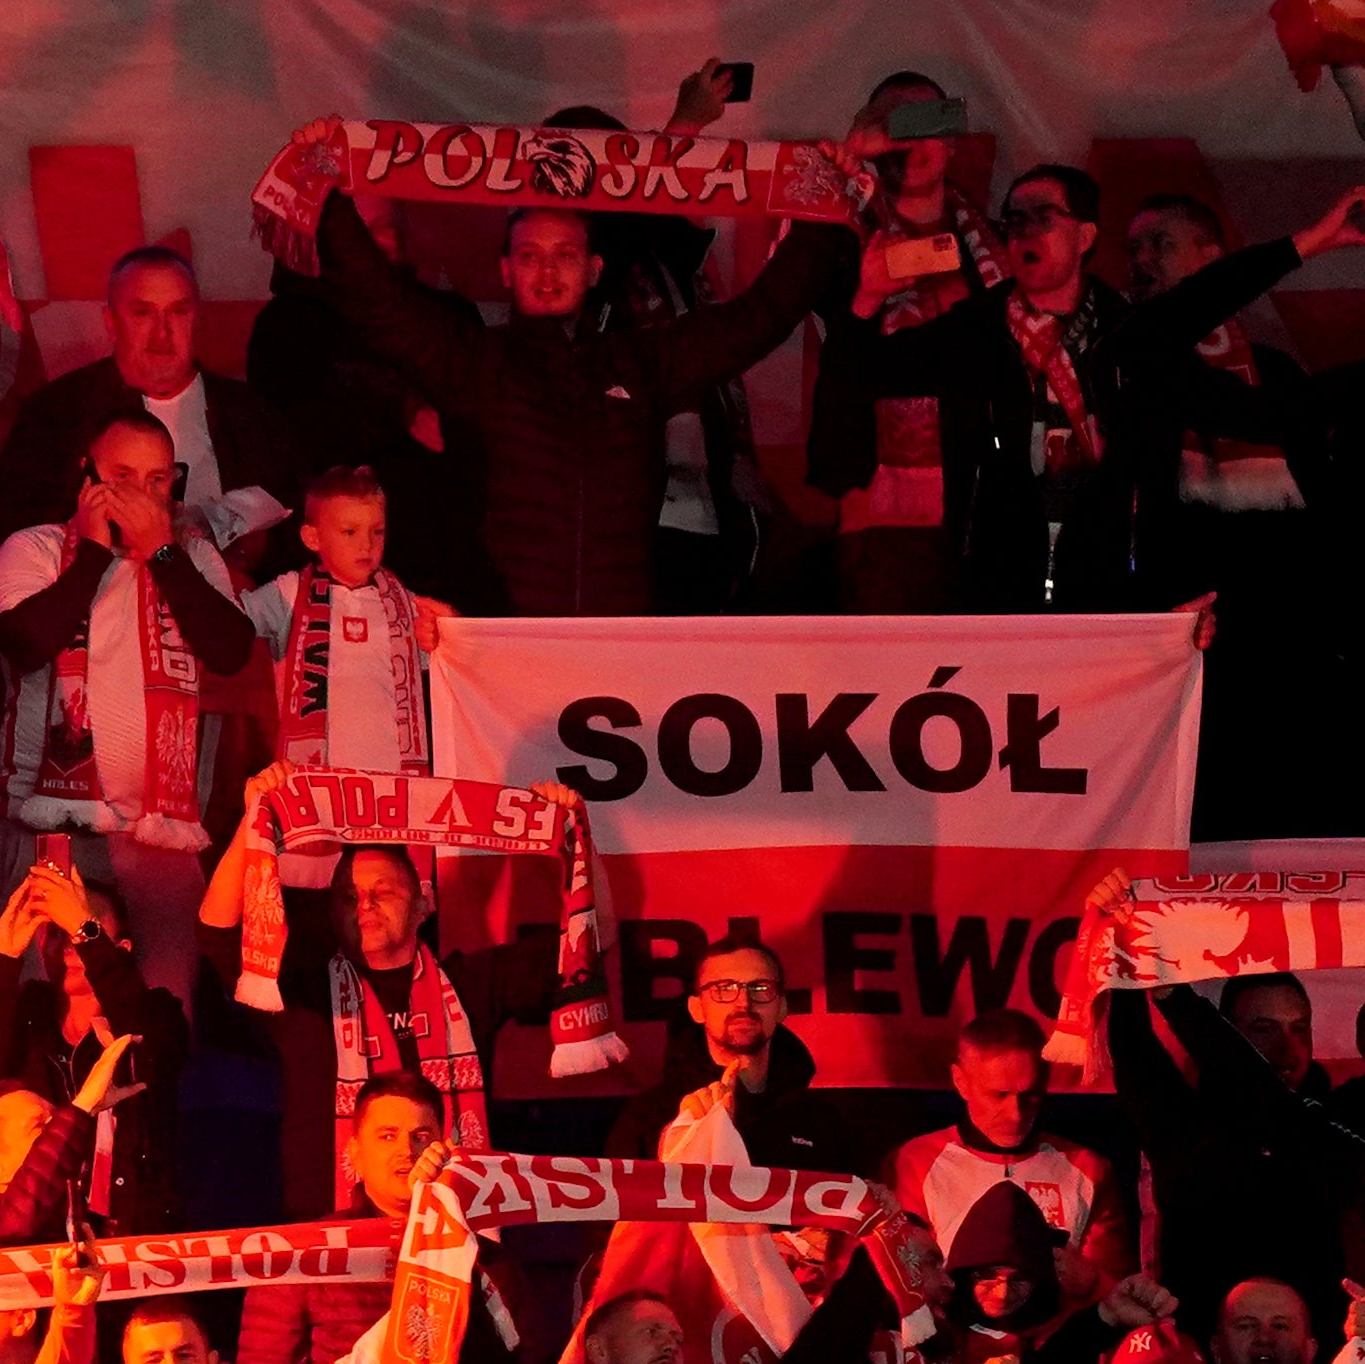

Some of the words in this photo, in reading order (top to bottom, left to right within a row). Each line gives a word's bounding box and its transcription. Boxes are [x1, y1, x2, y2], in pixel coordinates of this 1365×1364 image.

[368, 121, 525, 191] POL
[600, 134, 753, 201] SKA
[290, 615, 308, 713] CYMRU
[556, 667, 1088, 799] SOKÓŁ
[408, 1280, 452, 1303] POLSKA
